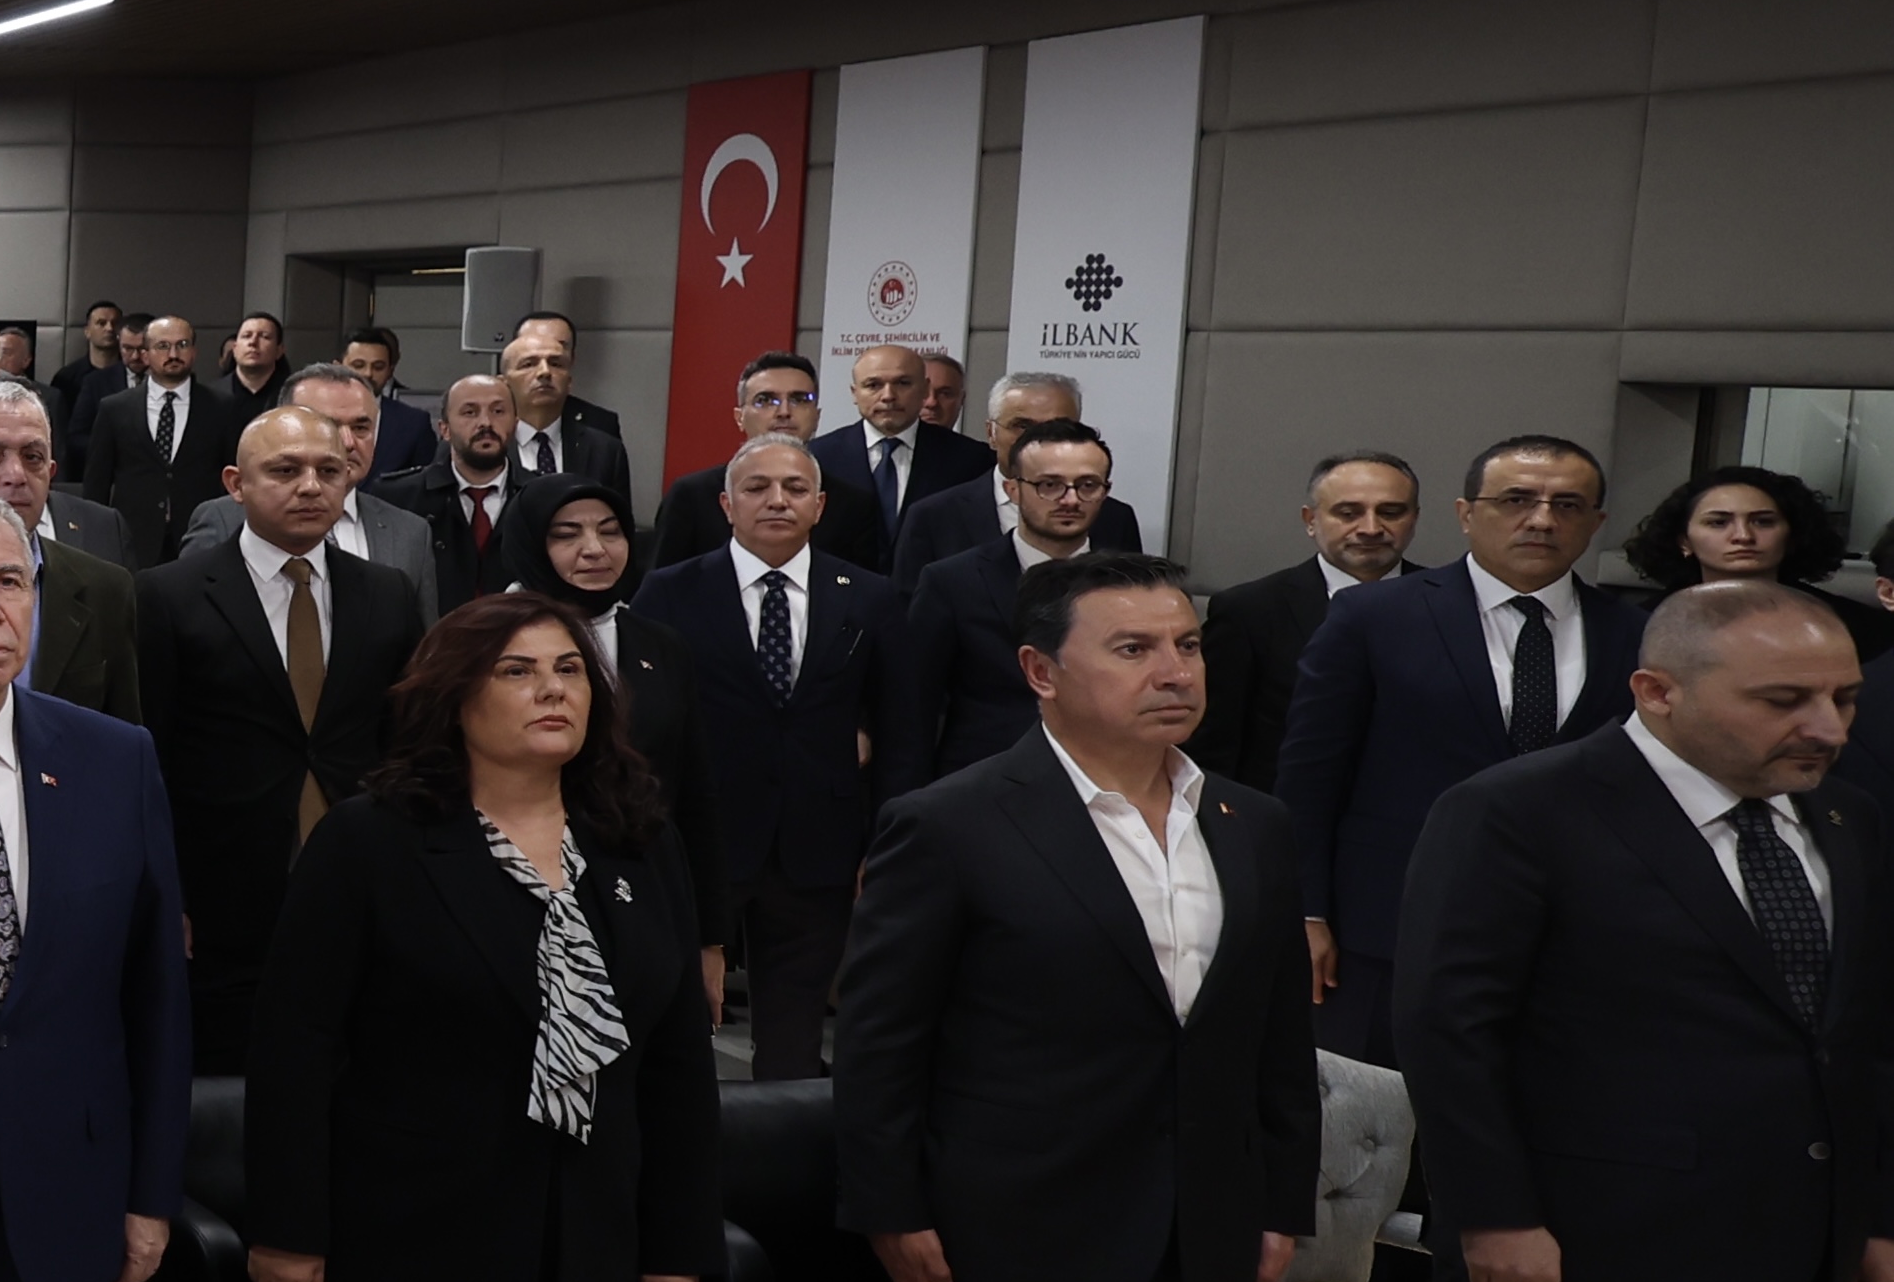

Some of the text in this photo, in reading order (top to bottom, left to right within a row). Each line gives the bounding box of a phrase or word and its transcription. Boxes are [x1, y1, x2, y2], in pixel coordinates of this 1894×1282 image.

[840, 333, 854, 343] T.C.
[884, 331, 928, 344] ŞEHİRCİLİK
[930, 333, 940, 342] VE
[831, 345, 853, 356] İKLİM
